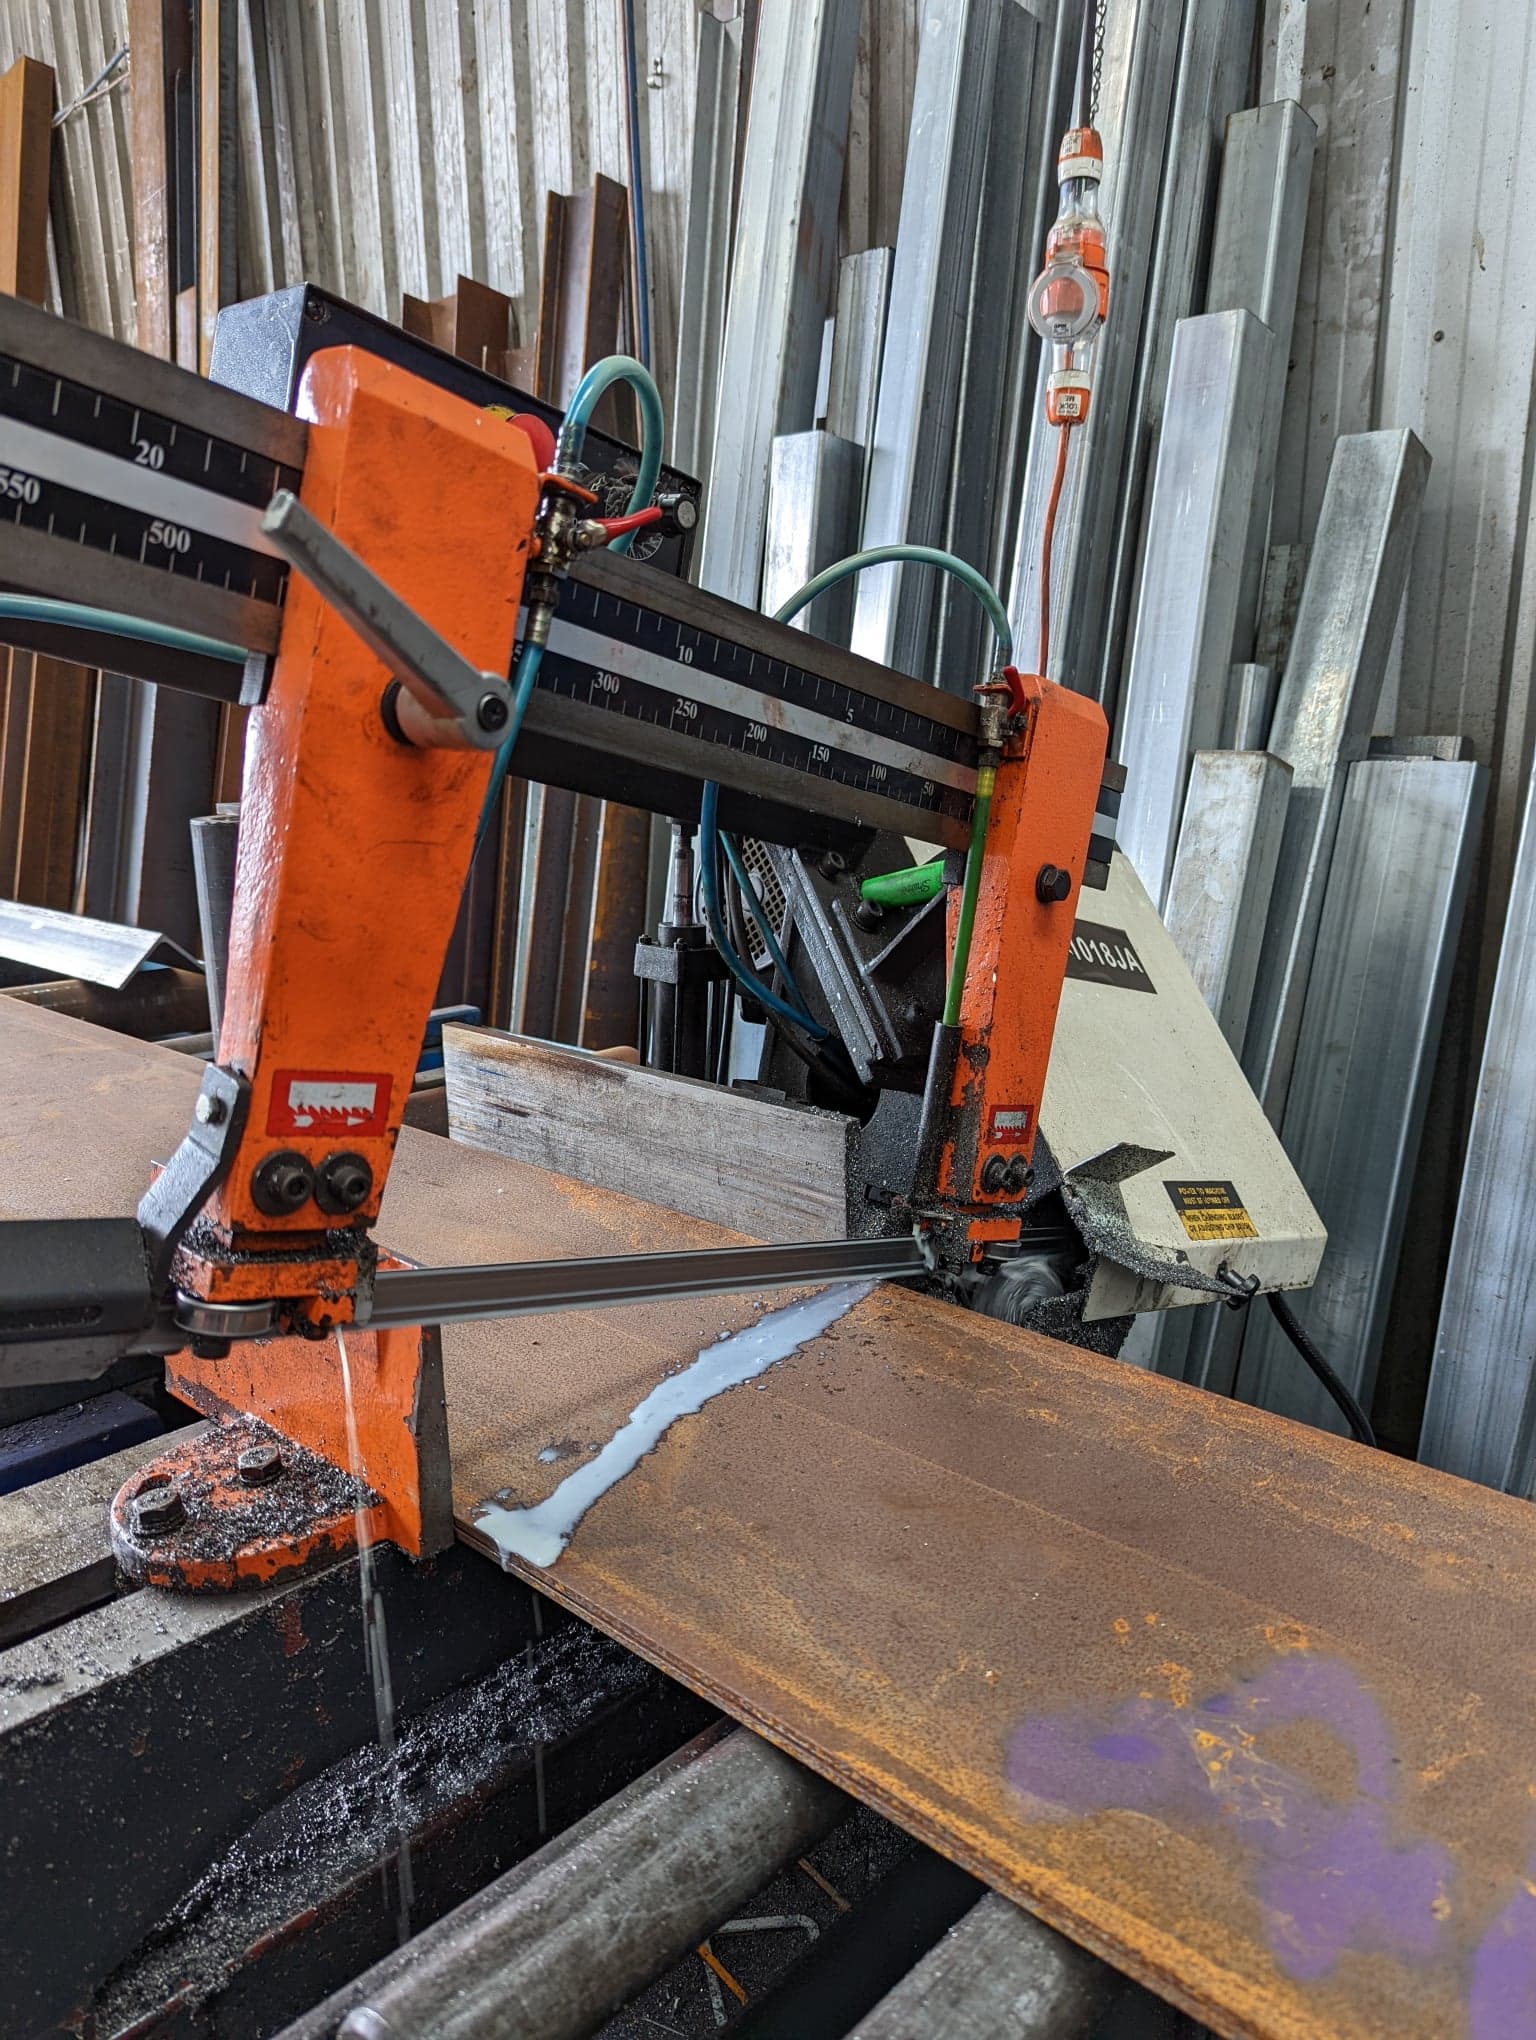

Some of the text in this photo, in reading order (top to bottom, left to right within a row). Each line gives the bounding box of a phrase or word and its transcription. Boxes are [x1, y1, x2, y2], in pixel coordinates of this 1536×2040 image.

[135, 440, 165, 470] 20
[148, 520, 191, 554] 500
[677, 645, 693, 664] 10
[593, 671, 620, 695] 300
[674, 698, 698, 720] 250
[846, 708, 855, 723] 5
[747, 722, 767, 742] 200
[812, 744, 830, 763] 150
[870, 764, 887, 782] 100
[922, 782, 934, 797] 50
